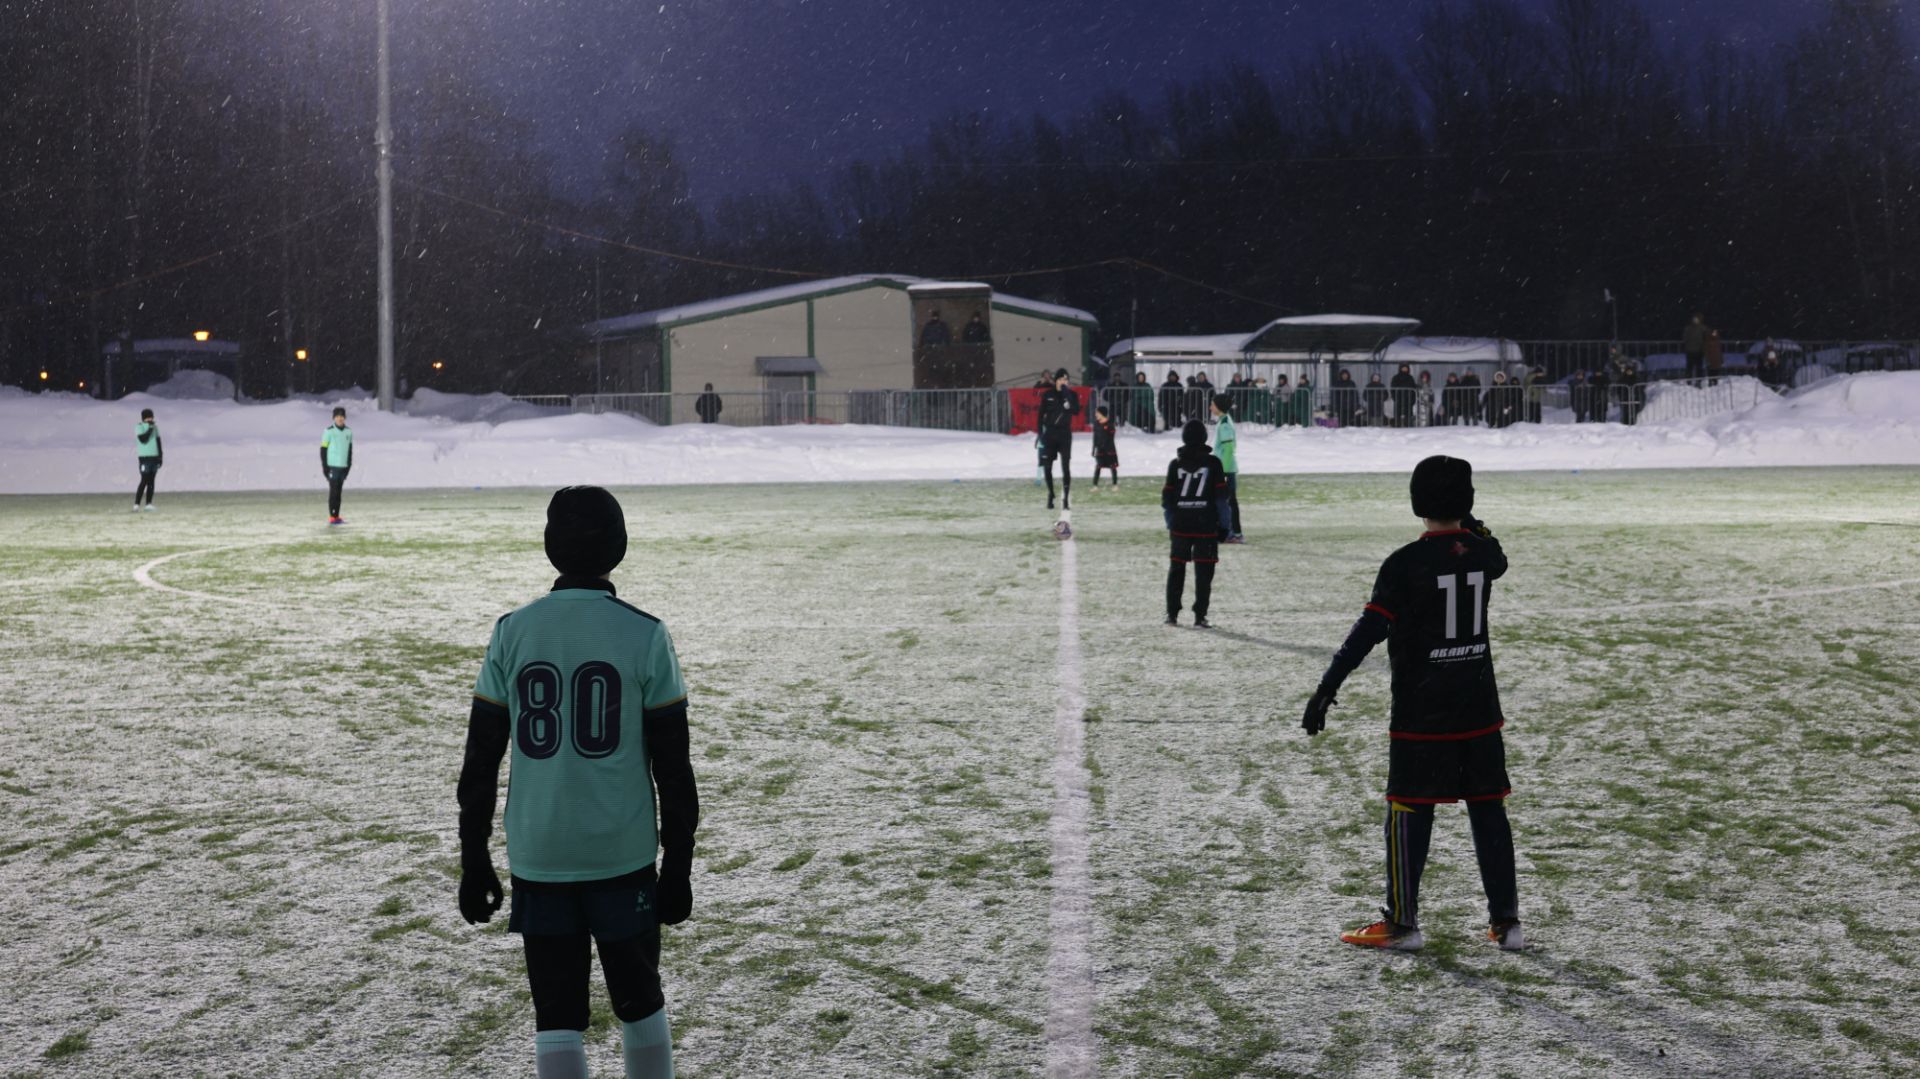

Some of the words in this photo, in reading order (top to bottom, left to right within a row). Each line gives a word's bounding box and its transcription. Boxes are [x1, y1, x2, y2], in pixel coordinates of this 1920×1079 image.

[1177, 467, 1208, 497] 77
[1437, 571, 1484, 639] 11
[1429, 643, 1486, 658] АВАНГАР
[516, 660, 622, 760] 80
